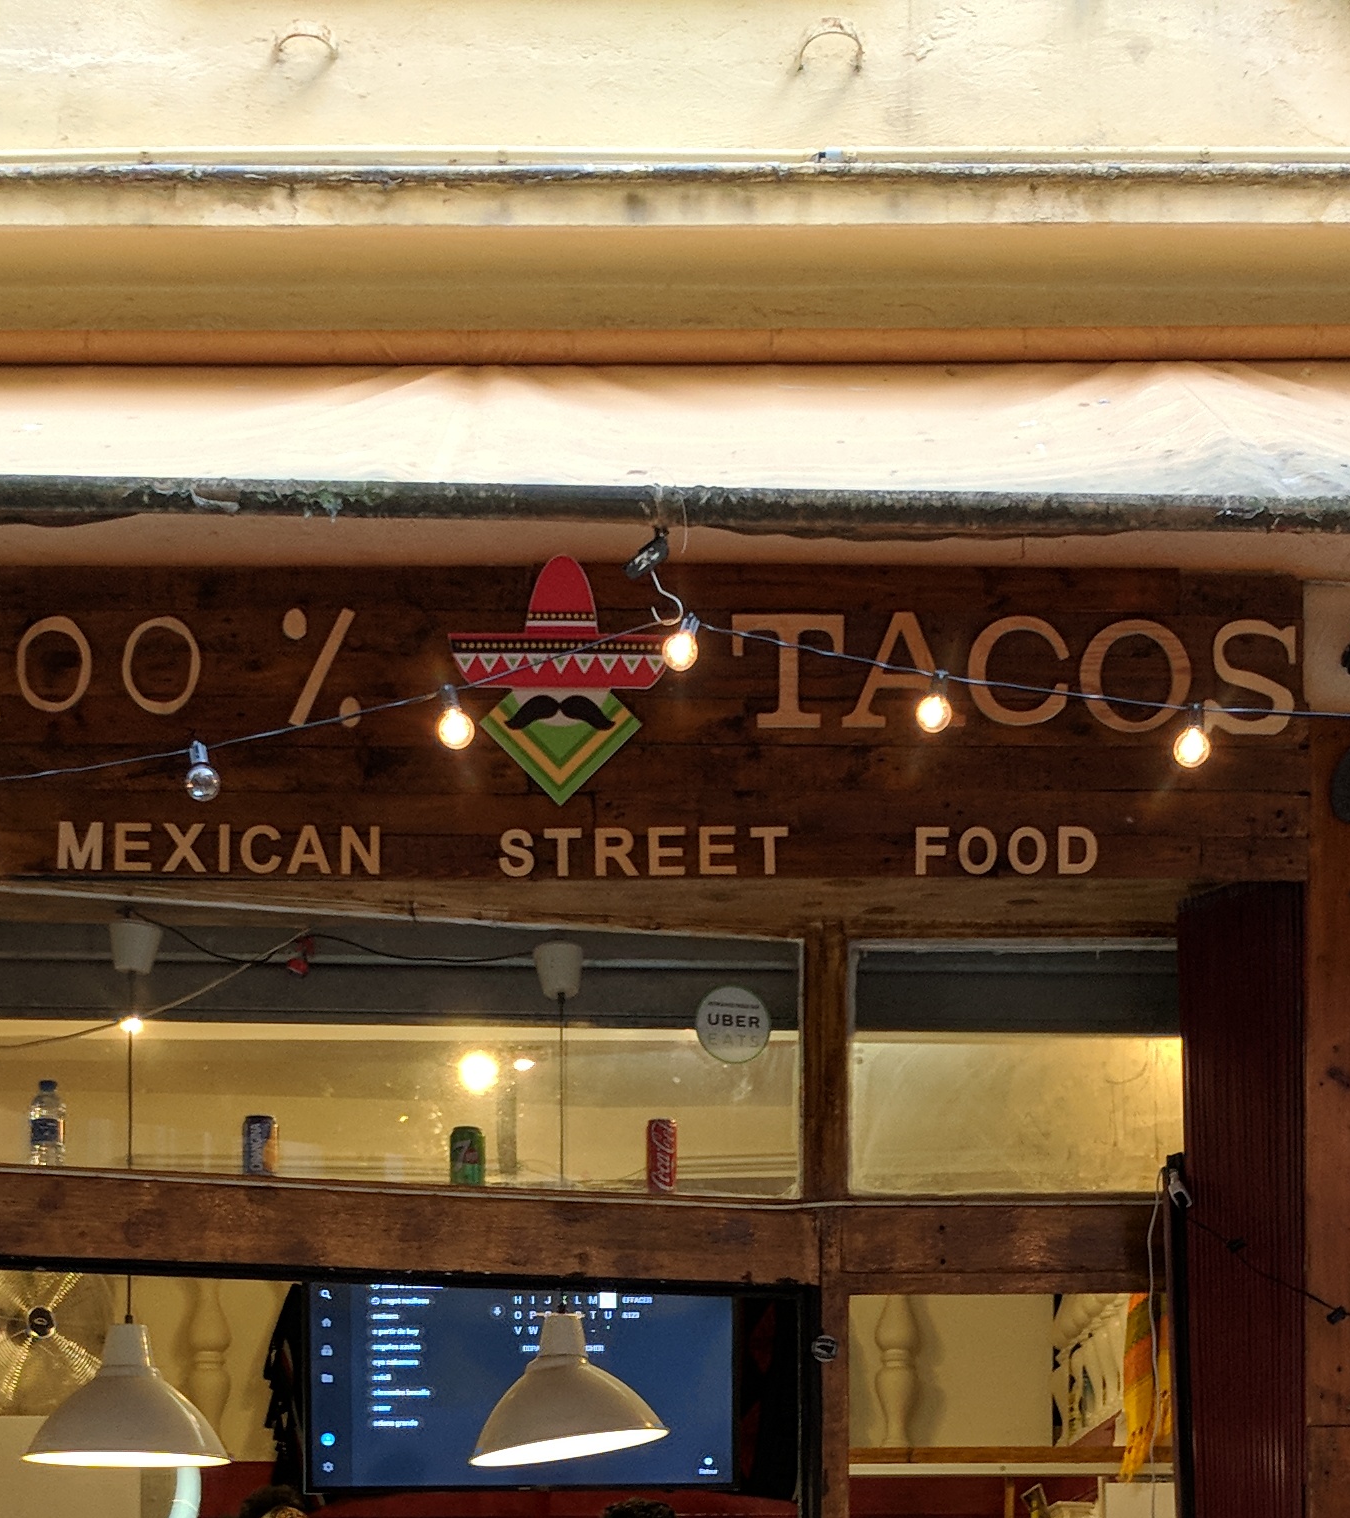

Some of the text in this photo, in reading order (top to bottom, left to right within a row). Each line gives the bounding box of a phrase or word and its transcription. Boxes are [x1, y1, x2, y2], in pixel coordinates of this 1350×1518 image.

[281, 607, 362, 728] %
[731, 610, 1299, 738] TACOS
[57, 819, 1098, 878] MEXICAN STREET FOOD
[707, 1013, 760, 1028] UBER
[707, 1031, 761, 1048] EATS
